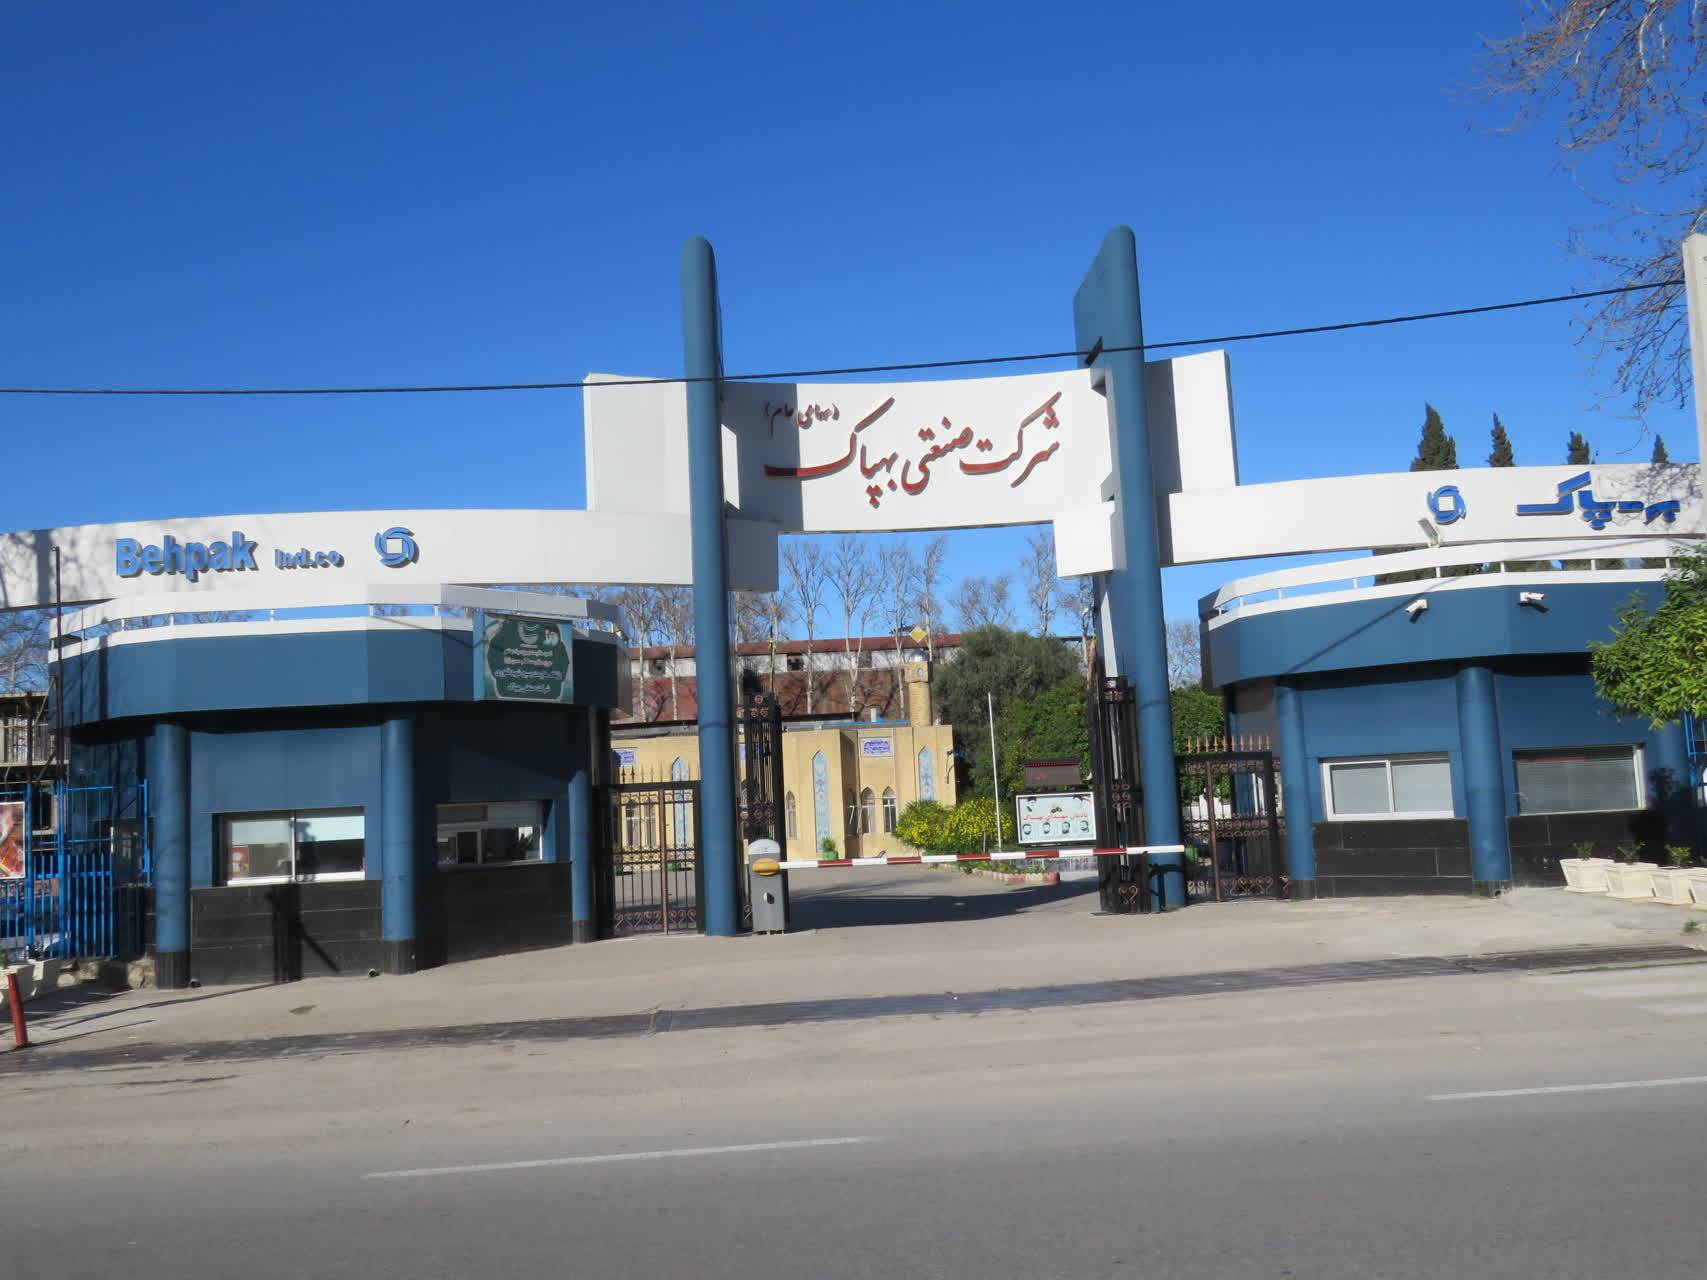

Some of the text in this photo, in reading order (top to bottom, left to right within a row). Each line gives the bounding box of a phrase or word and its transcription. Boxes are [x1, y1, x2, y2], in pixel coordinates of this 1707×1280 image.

[763, 391, 1062, 509] شرکت صنعتی بهپاک
[1516, 471, 1681, 530] بهپاک
[115, 530, 258, 583] Behpak
